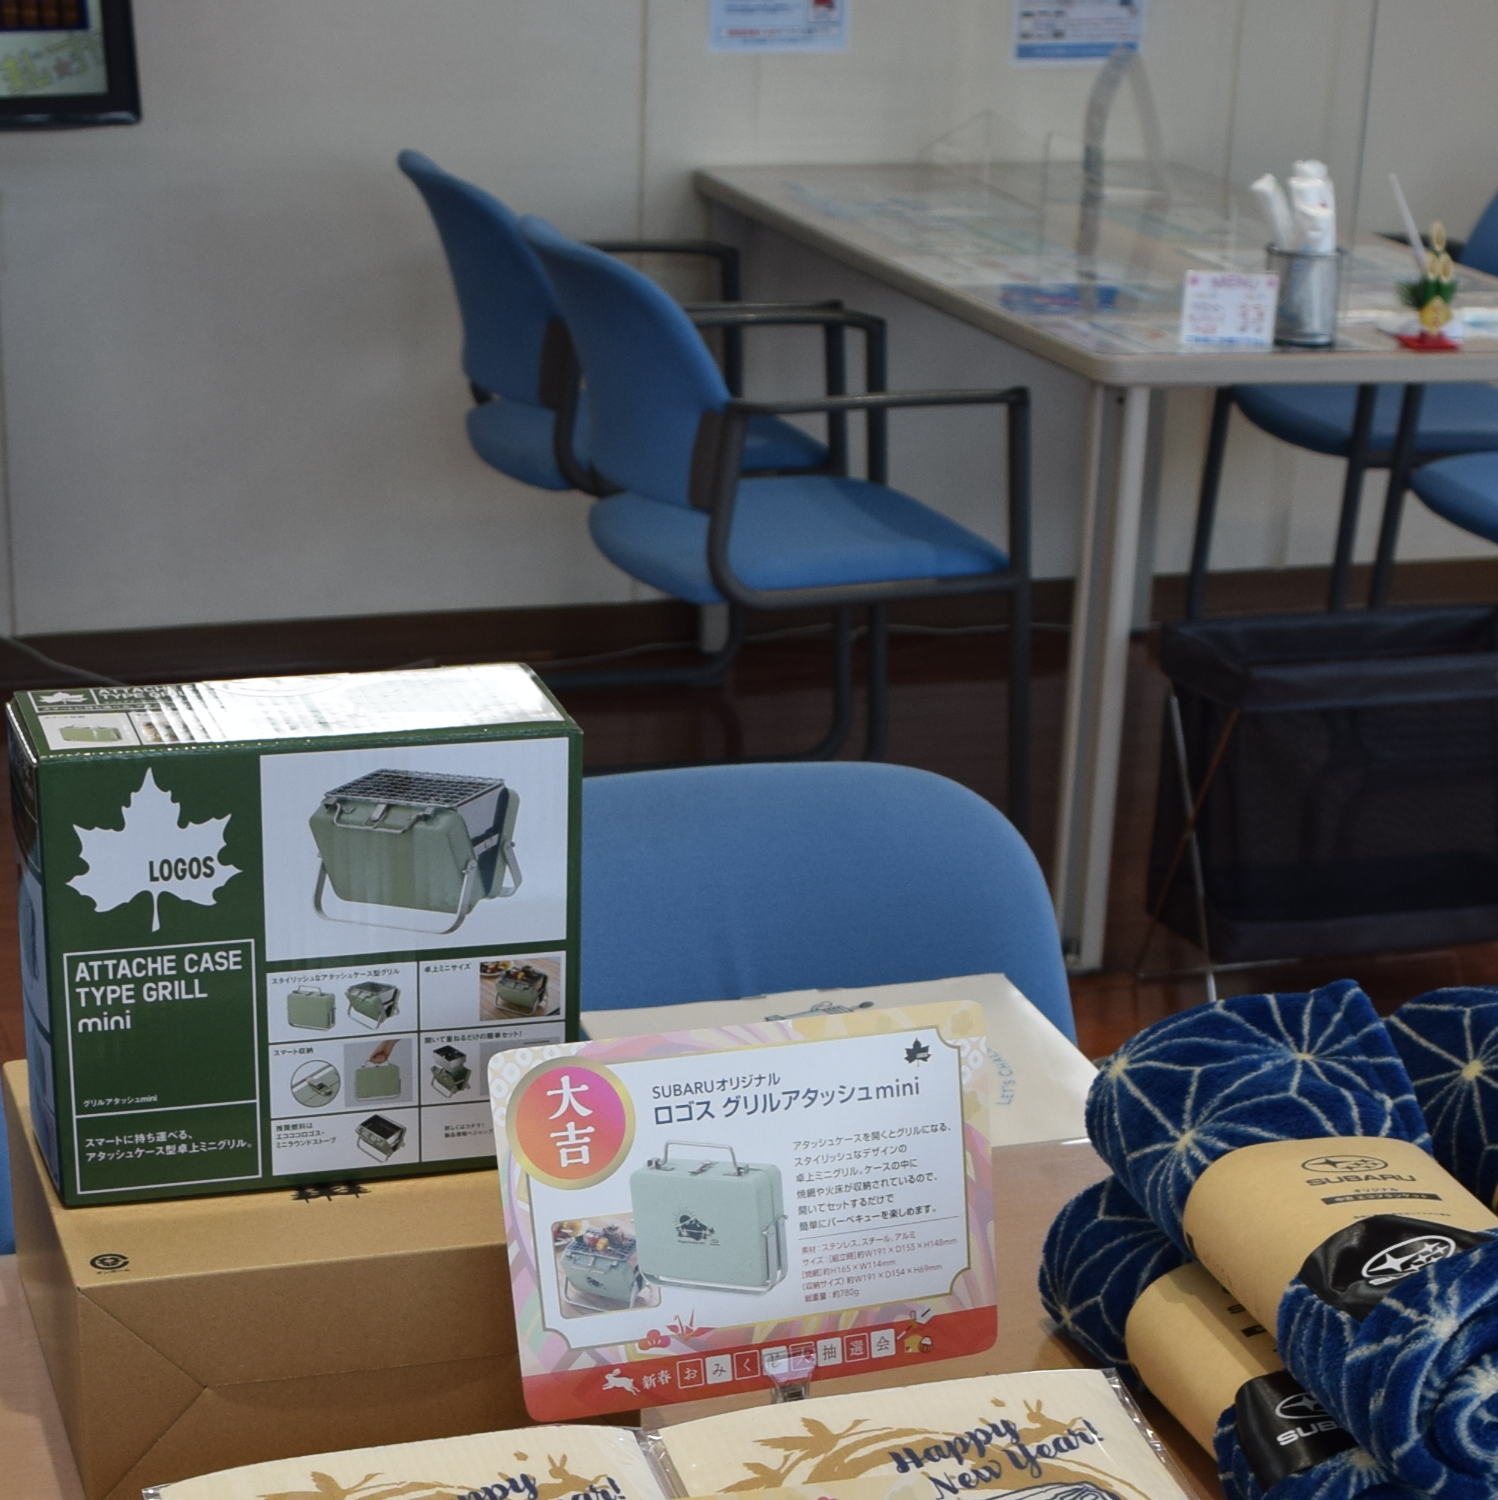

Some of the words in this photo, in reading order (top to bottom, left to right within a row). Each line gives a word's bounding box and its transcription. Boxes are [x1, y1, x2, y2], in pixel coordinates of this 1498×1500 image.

[148, 856, 216, 883] LOGOS
[75, 954, 177, 984] ATTACHE
[184, 949, 243, 974] CASE
[76, 985, 136, 1007] TYPE
[142, 979, 208, 1003] GRILL
[77, 1010, 132, 1033] mini
[652, 1071, 781, 1100] SUBARUオリジナル
[654, 1101, 717, 1126] ロゴス
[722, 1076, 922, 1119] グリルアタッシュmini
[546, 1075, 593, 1168] 大吉
[85, 1129, 193, 1148] スマートに持ち運べる、
[793, 1122, 952, 1150] アタッシュケースを開くとグリルになる、
[85, 1138, 253, 1162] アタッシュケース型卓上ミニグリル。
[795, 1144, 908, 1167] スタイリッシュなデザインの
[796, 1158, 919, 1183] 卓上ミニグリル。ケースの中に
[1306, 1174, 1417, 1186] SUBARU
[798, 1194, 895, 1216] 開いてセットするだけで
[799, 1204, 937, 1232] 簡単にバーベキューを楽しめます。
[1276, 1420, 1340, 1446] SUB
[889, 1417, 1021, 1477] Happy
[928, 1459, 1003, 1500] New
[1004, 1420, 1105, 1479] Year!
